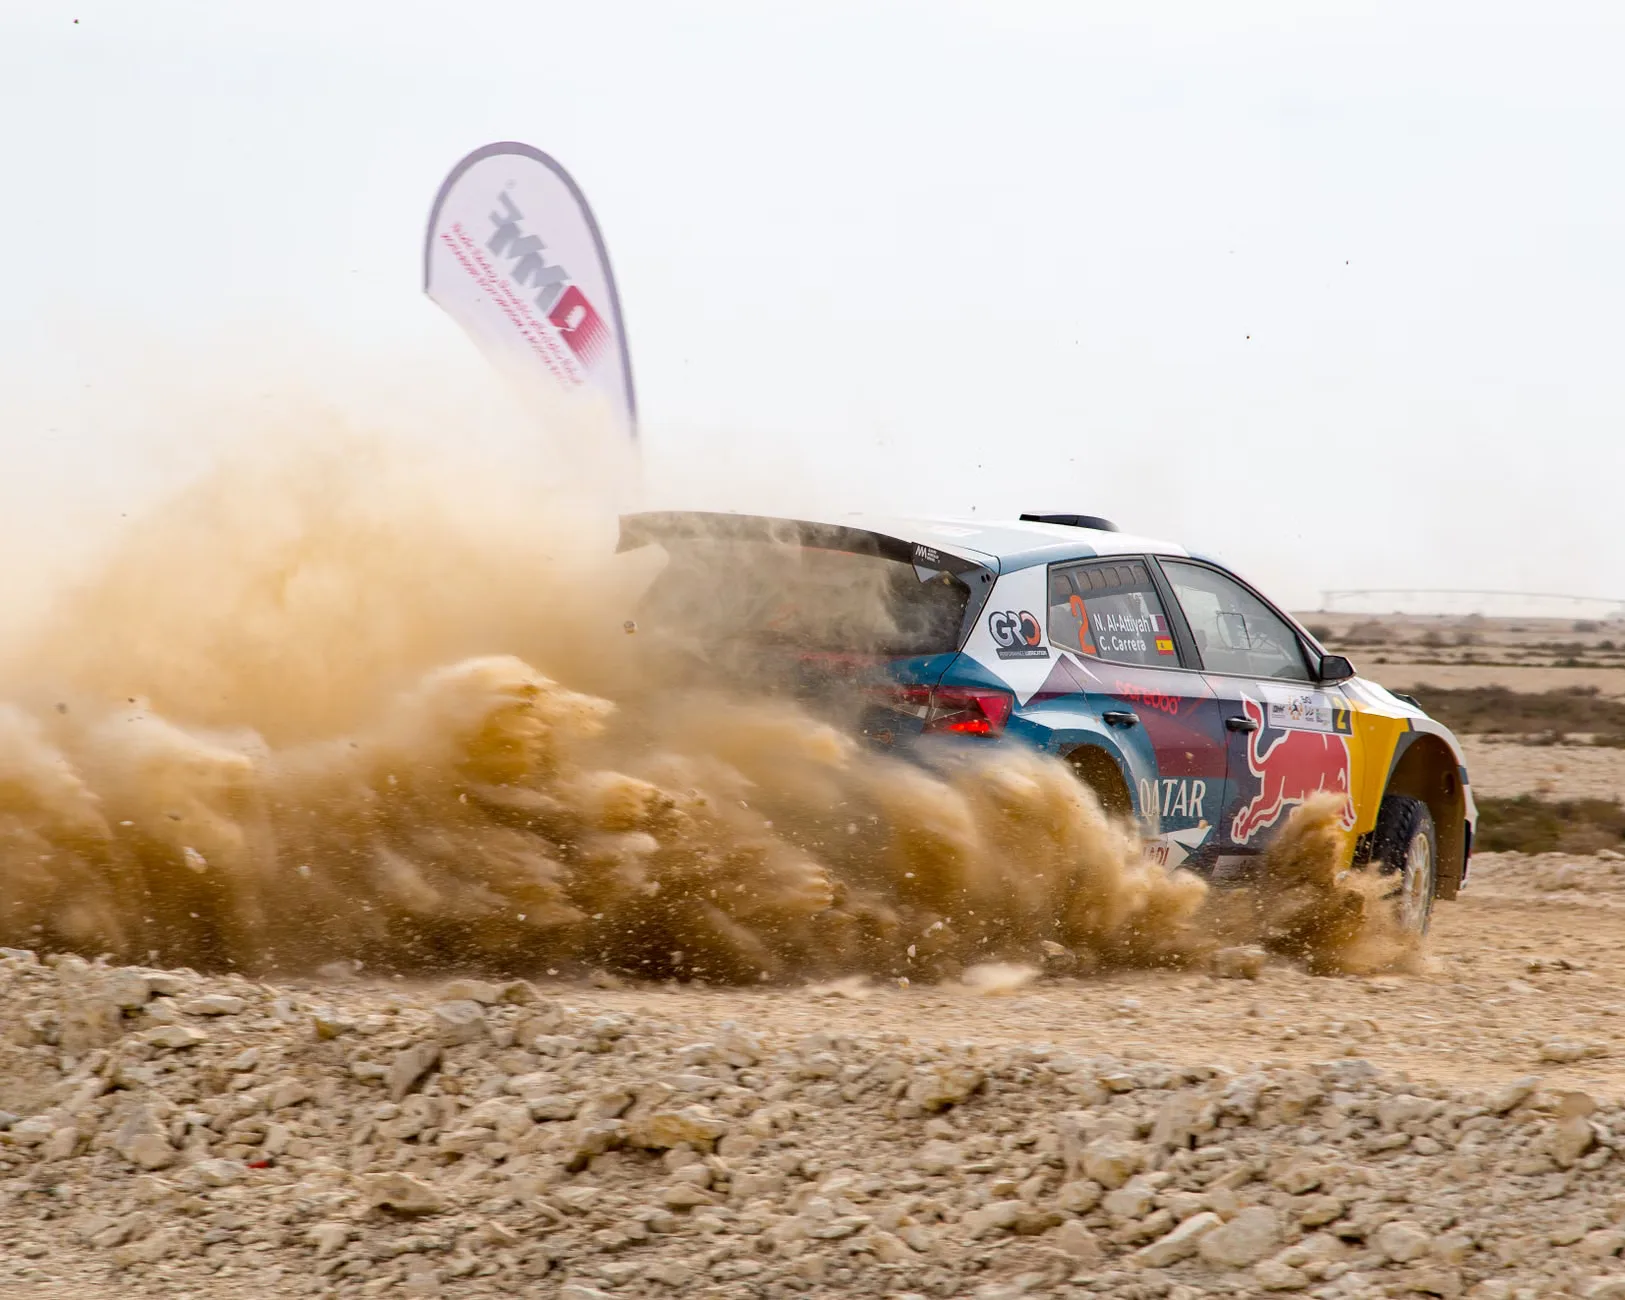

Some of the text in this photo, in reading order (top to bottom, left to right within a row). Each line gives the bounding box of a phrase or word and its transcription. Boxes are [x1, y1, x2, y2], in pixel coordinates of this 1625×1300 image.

[1069, 594, 1097, 654] 2
[1093, 614, 1150, 636] N. Al-Attiyah
[1099, 637, 1147, 652] C. Carrera
[1332, 696, 1346, 729] 2
[1140, 778, 1206, 822] QATAR
